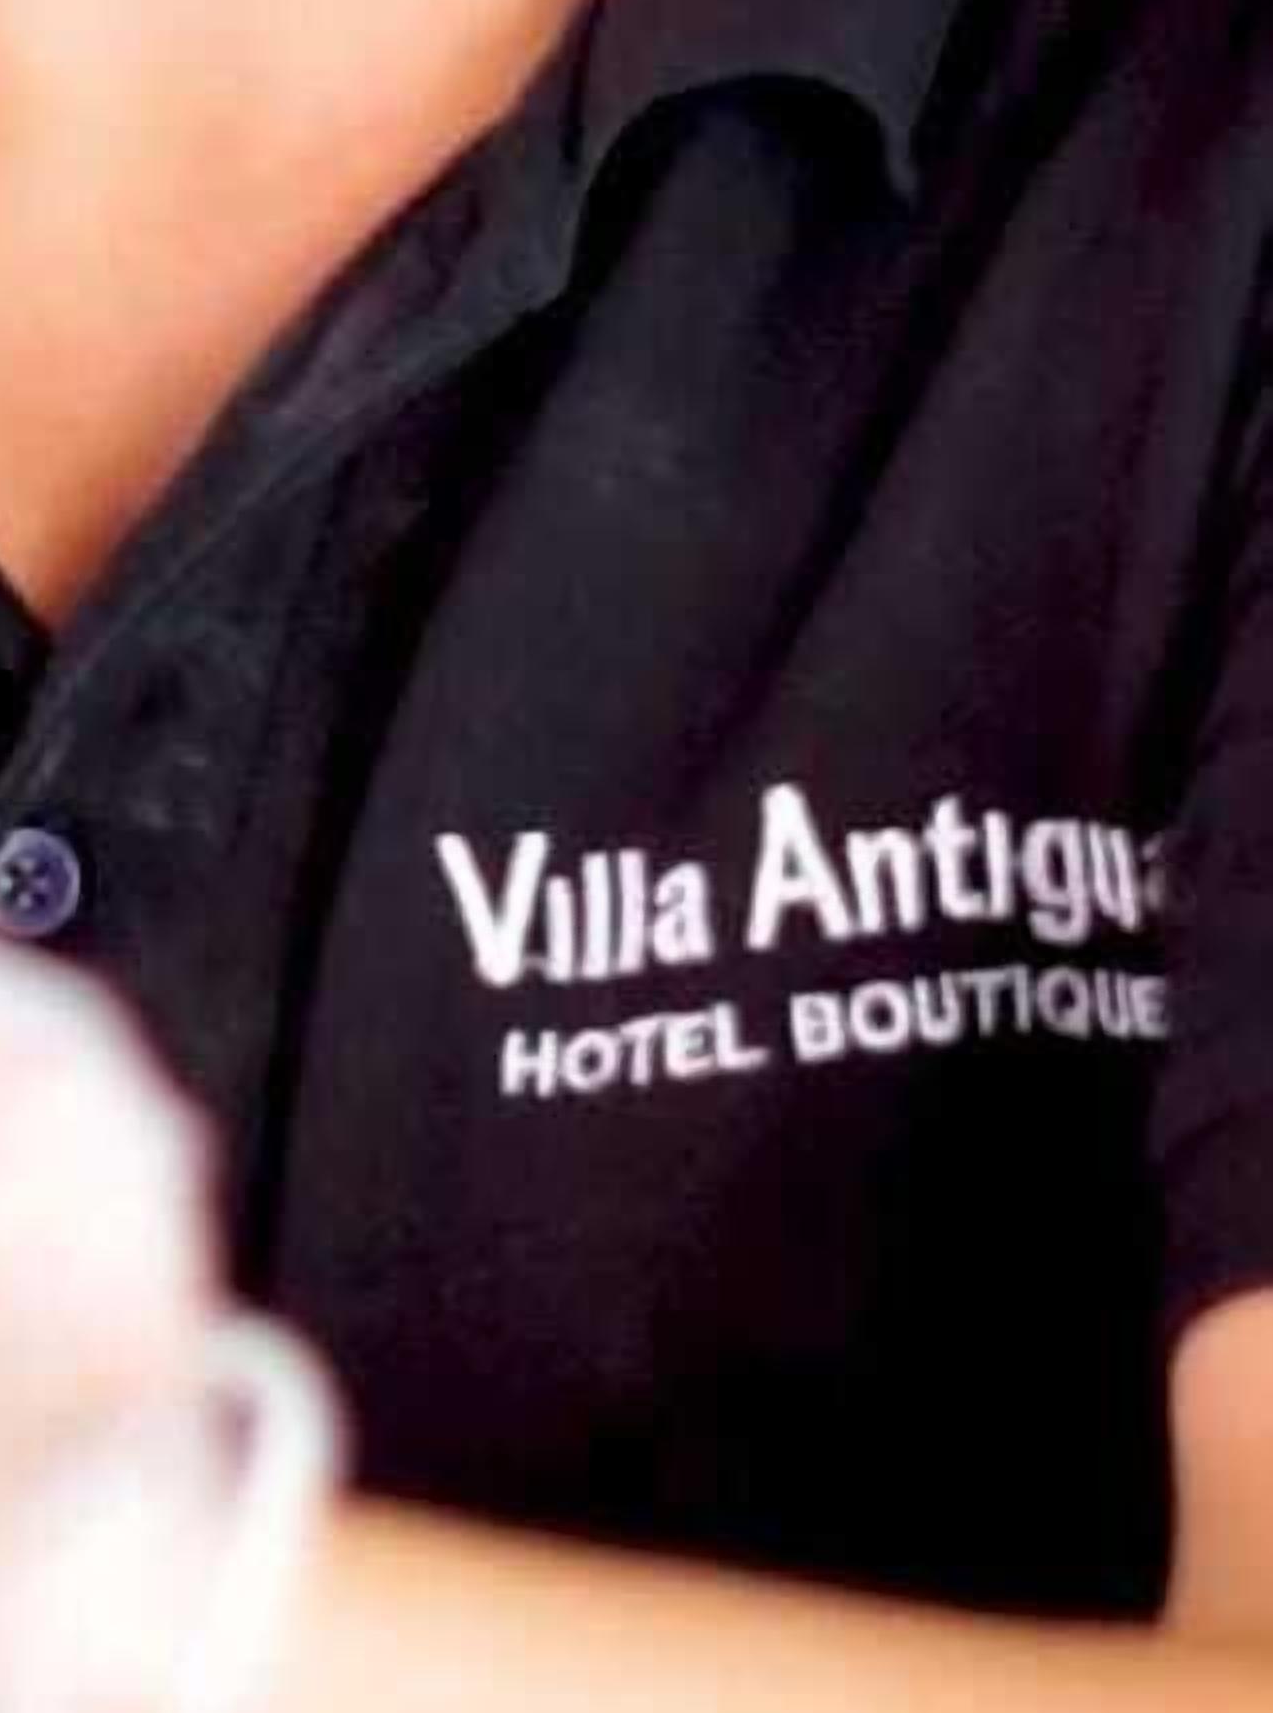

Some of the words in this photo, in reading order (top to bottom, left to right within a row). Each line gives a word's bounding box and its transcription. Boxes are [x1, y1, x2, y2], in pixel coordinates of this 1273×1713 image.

[435, 829, 713, 987] Villa
[500, 1004, 770, 1099] HOTEL
[790, 967, 1170, 1062] BOUTIQUE
